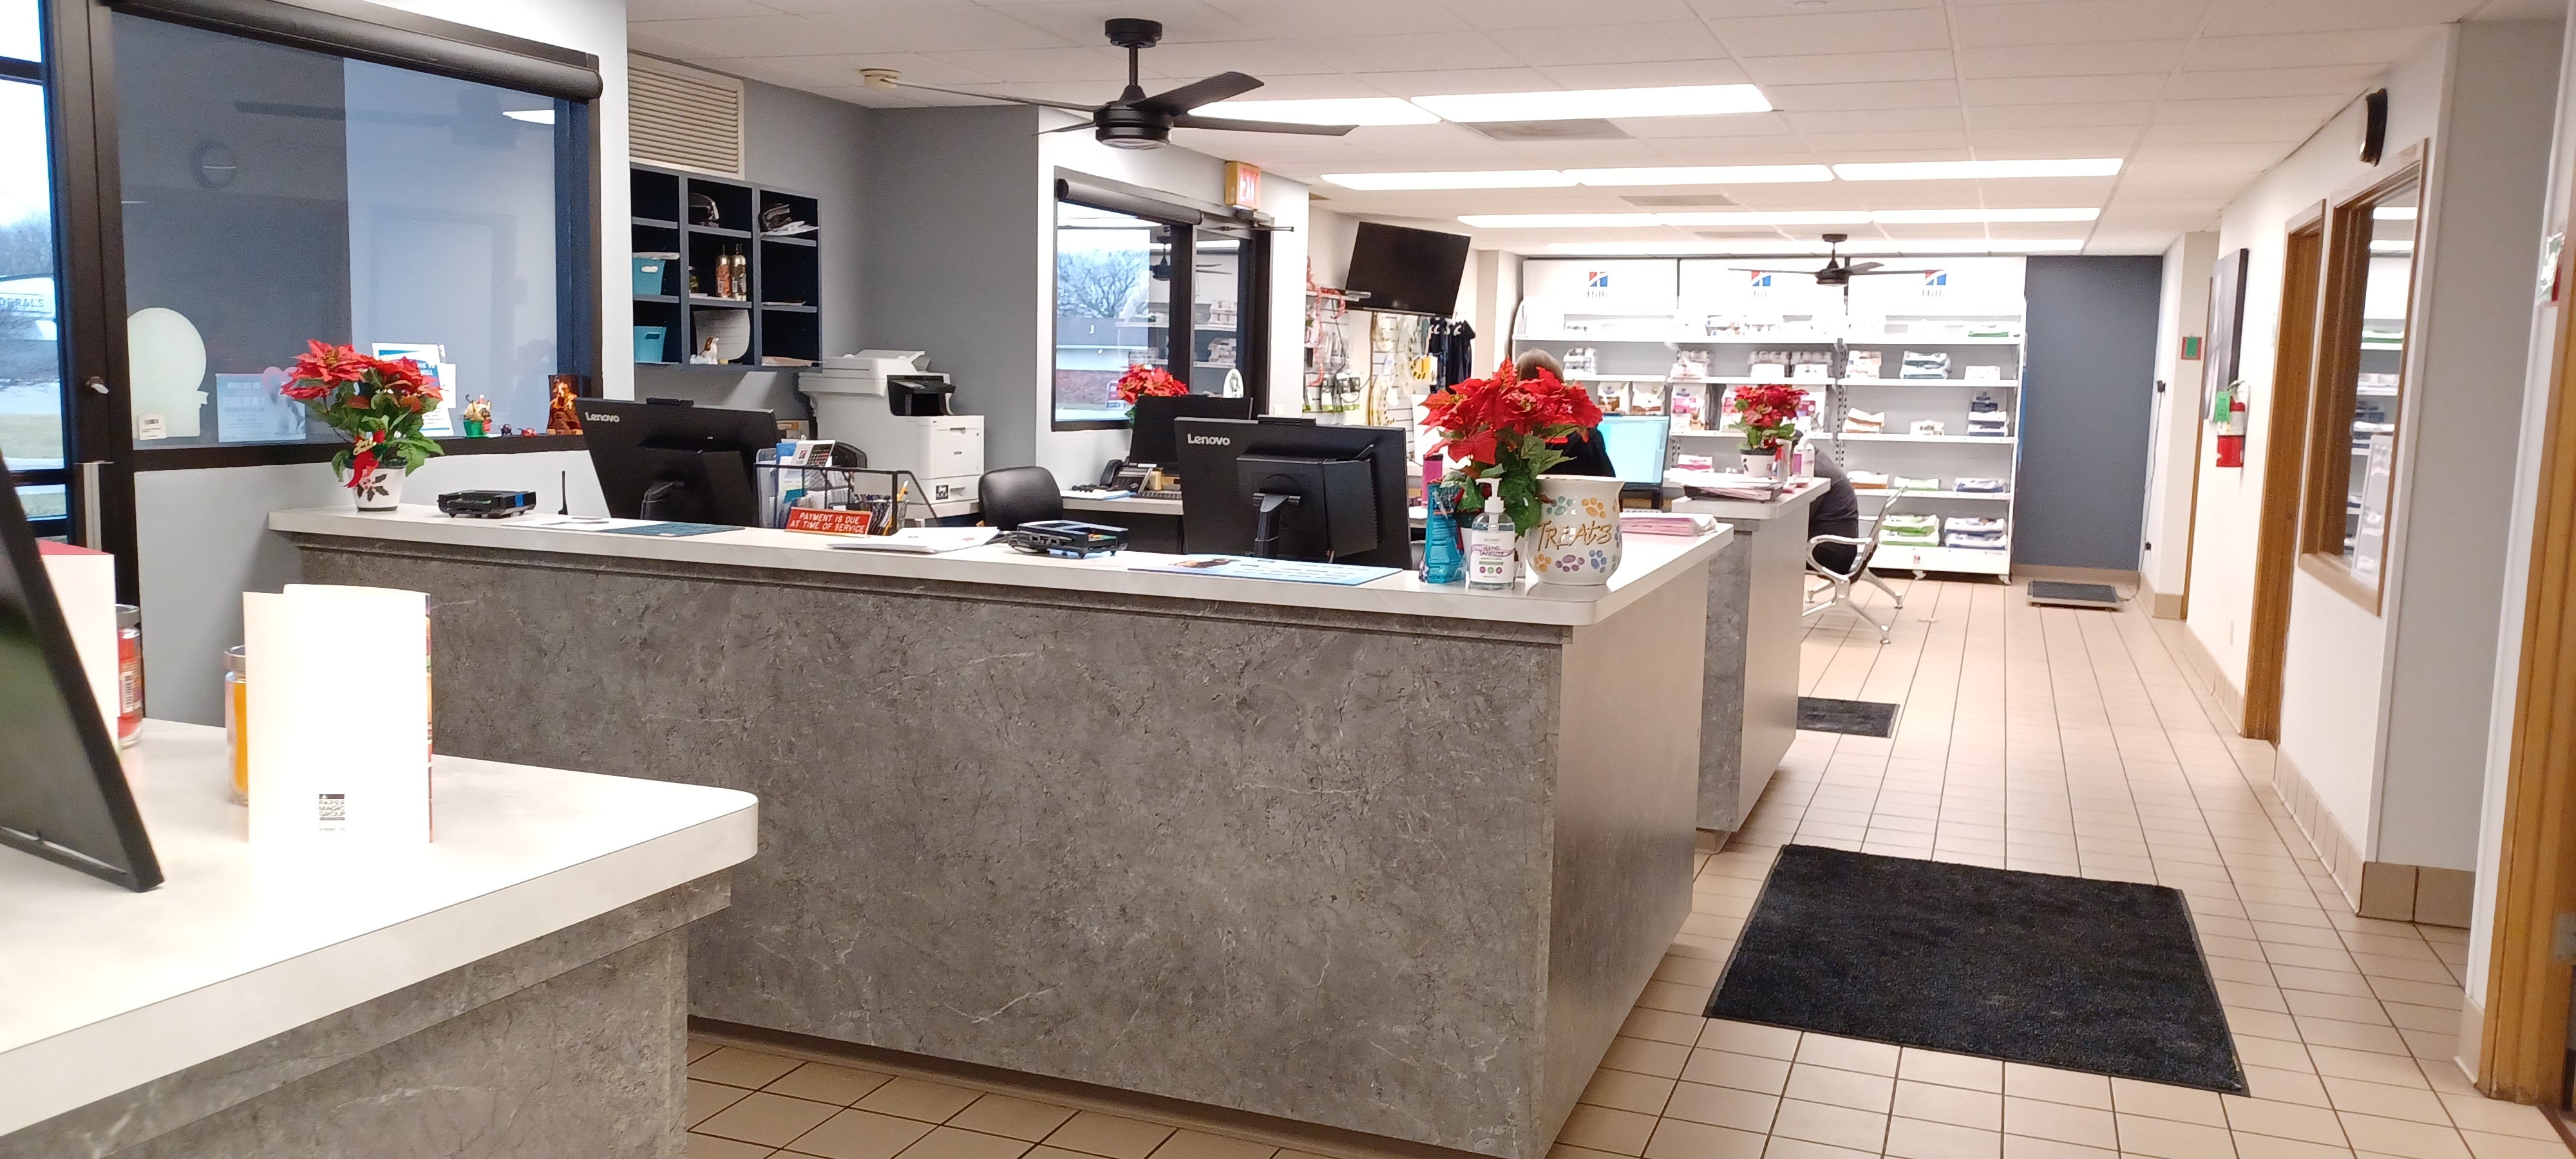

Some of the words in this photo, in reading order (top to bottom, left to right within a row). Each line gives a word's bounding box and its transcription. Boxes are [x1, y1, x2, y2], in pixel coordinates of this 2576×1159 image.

[585, 411, 620, 422] Lenovo
[1187, 433, 1231, 446] Lenovo
[799, 512, 833, 522] PAYMENT
[844, 516, 860, 525] DUE
[790, 520, 800, 528] AT
[802, 520, 820, 530] TIME
[822, 522, 833, 531] OF
[835, 523, 865, 533] SERVICE
